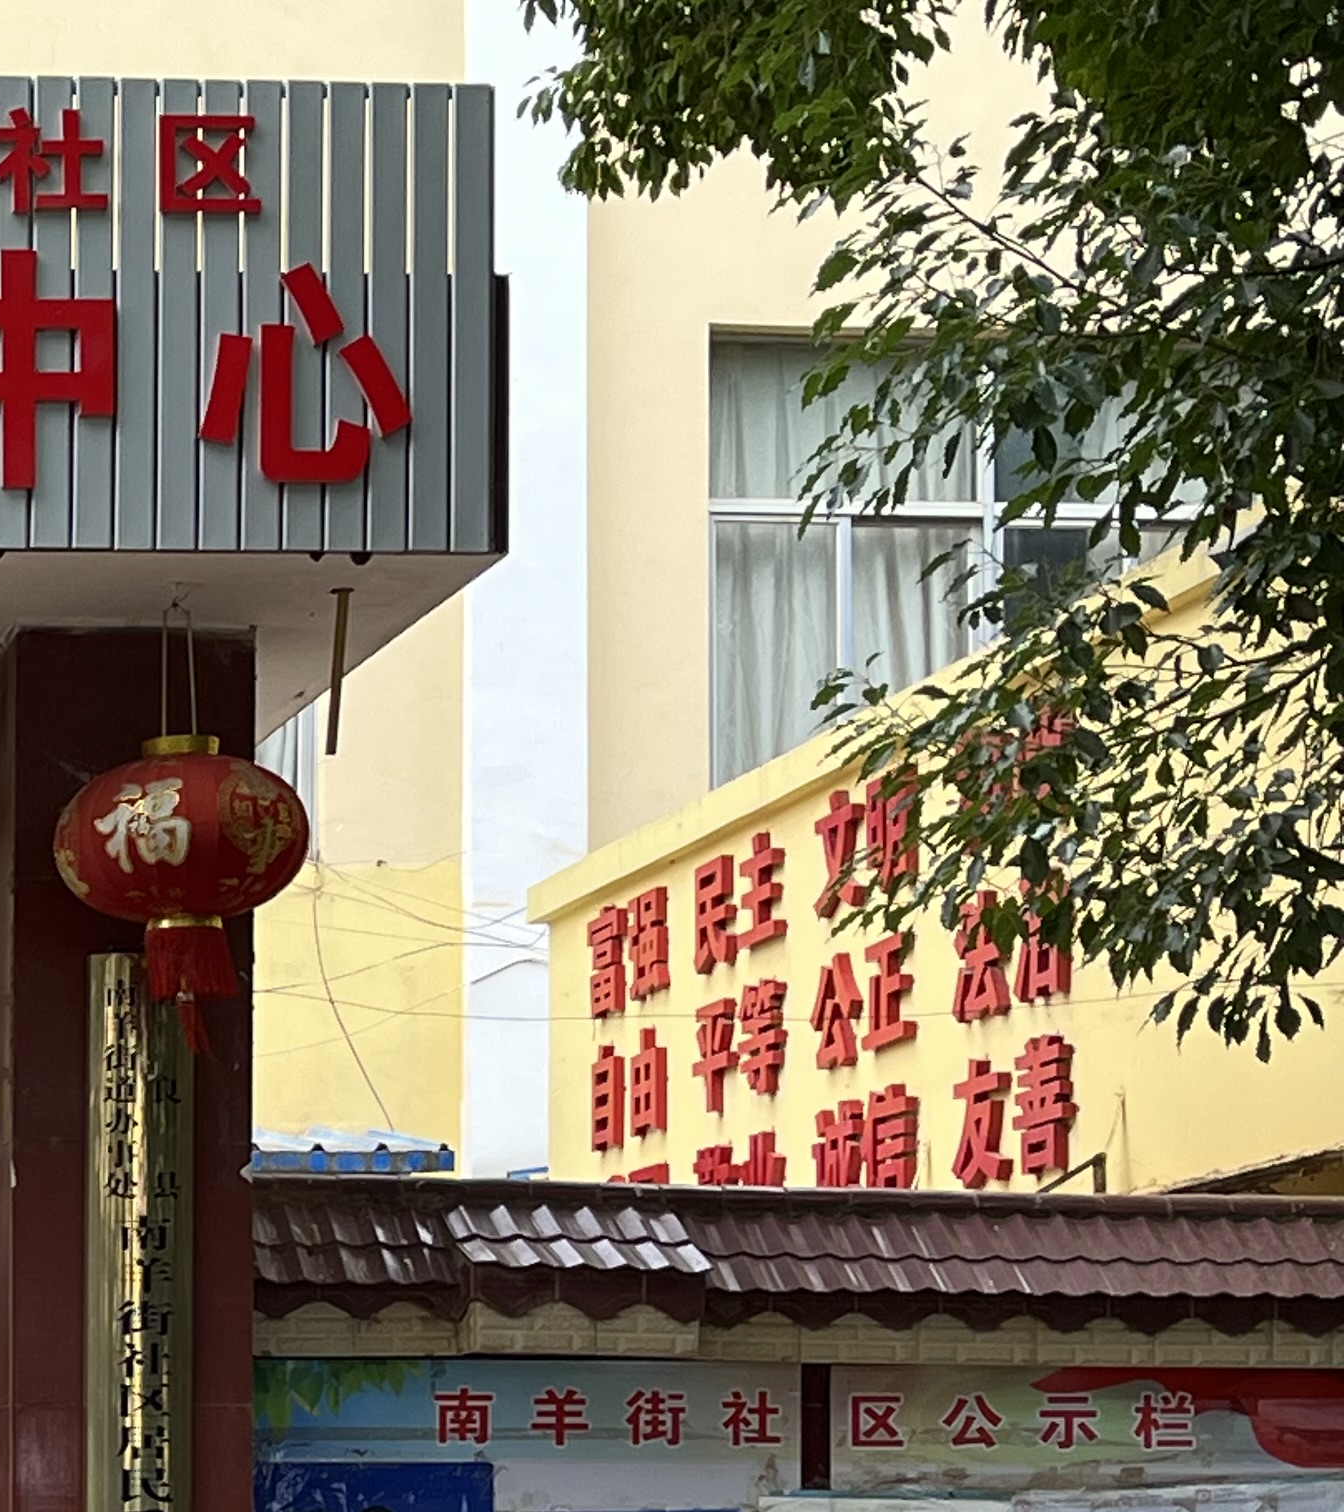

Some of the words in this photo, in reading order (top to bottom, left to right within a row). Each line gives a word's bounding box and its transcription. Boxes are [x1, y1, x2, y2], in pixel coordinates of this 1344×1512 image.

[94, 776, 192, 874] 福
[587, 885, 671, 1019] 富强
[693, 831, 787, 975] 民主
[591, 1027, 669, 1153] 自由
[692, 979, 787, 1115] 平等
[811, 931, 918, 1070] 公正
[953, 1034, 1080, 1190] 友善
